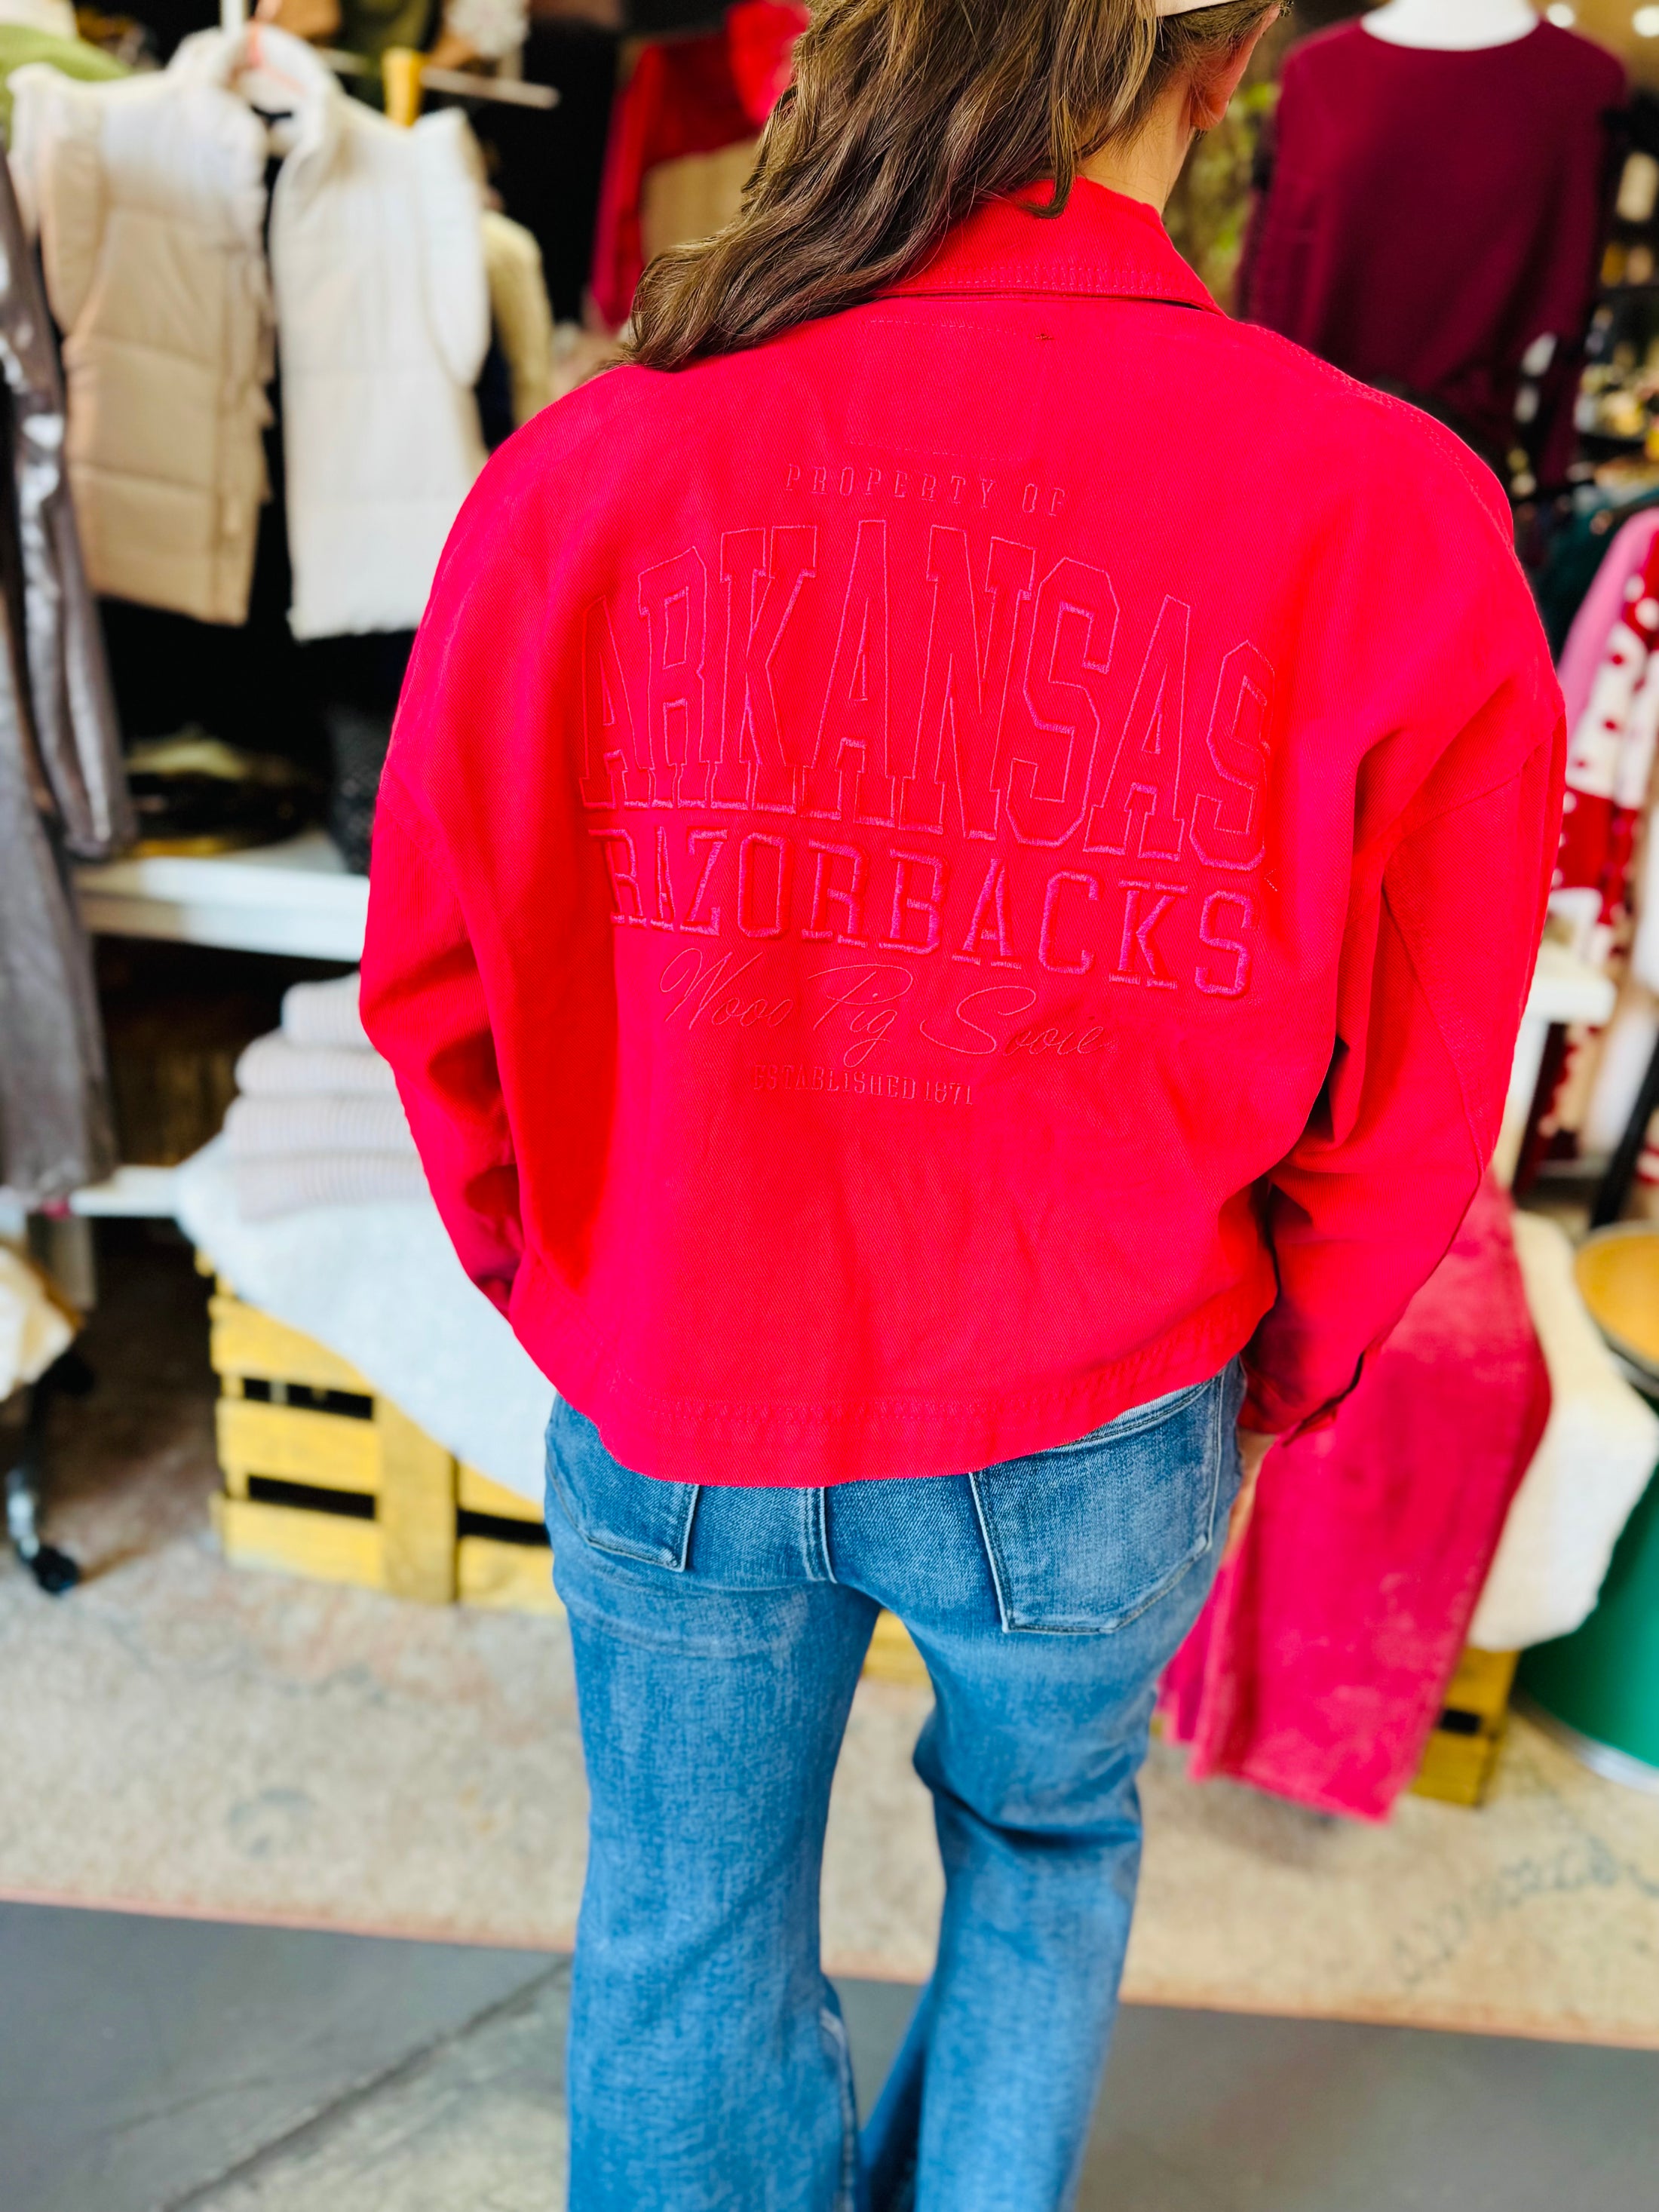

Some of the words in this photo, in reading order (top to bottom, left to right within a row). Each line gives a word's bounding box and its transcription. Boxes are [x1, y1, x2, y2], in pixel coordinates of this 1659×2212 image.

[785, 462, 997, 509] PROPERTY
[1021, 483, 1066, 517] OF
[578, 519, 1276, 872] ARKANSAS
[587, 825, 1260, 1000] RAZORBACKS
[808, 962, 914, 1068] Pig
[753, 1063, 917, 1100] ESTABLISHED
[923, 1080, 974, 1106] 1871
